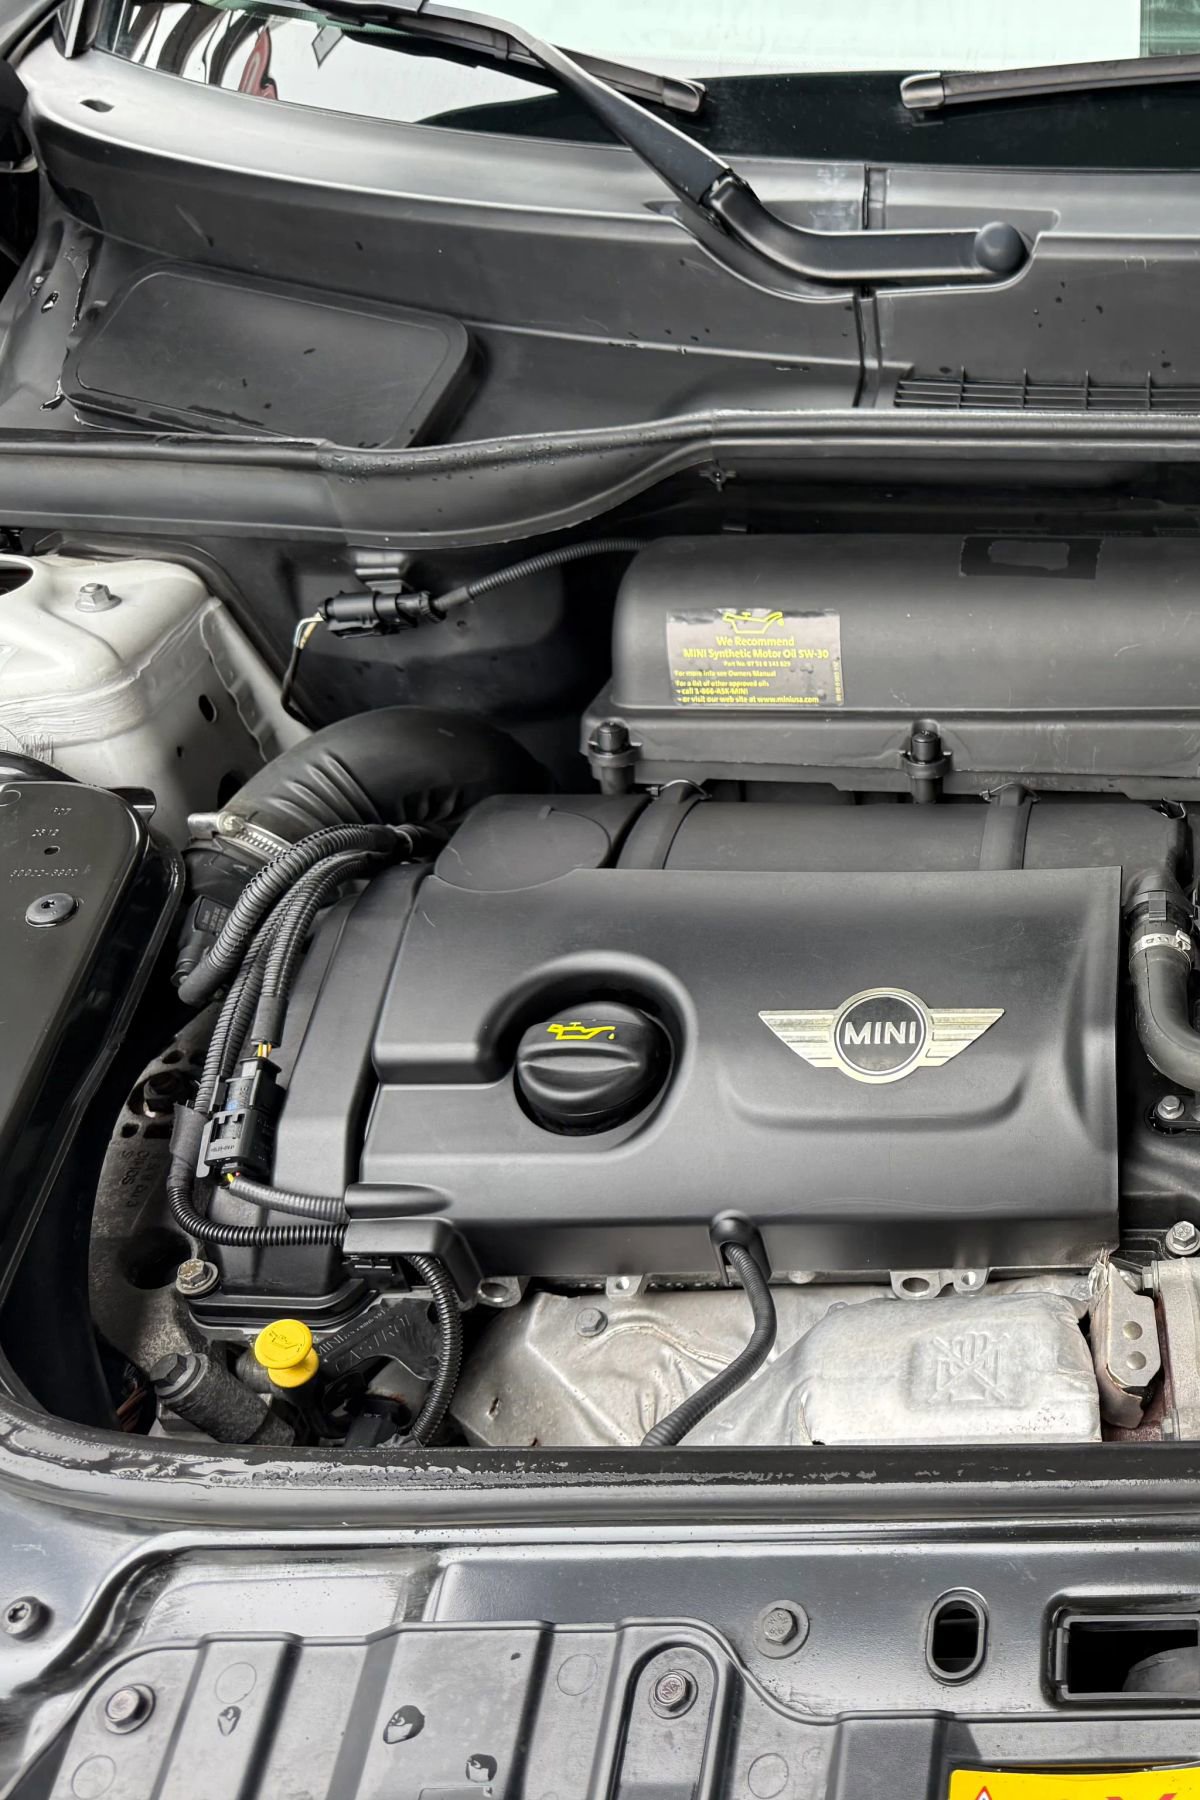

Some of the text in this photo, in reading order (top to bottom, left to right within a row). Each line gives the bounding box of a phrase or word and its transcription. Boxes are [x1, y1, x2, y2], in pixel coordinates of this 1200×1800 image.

[716, 635, 795, 647] We Recommend
[683, 648, 829, 661] MINI Synthetic Motor Oil 5W-30
[681, 687, 694, 695] call
[844, 1021, 917, 1045] MINI
